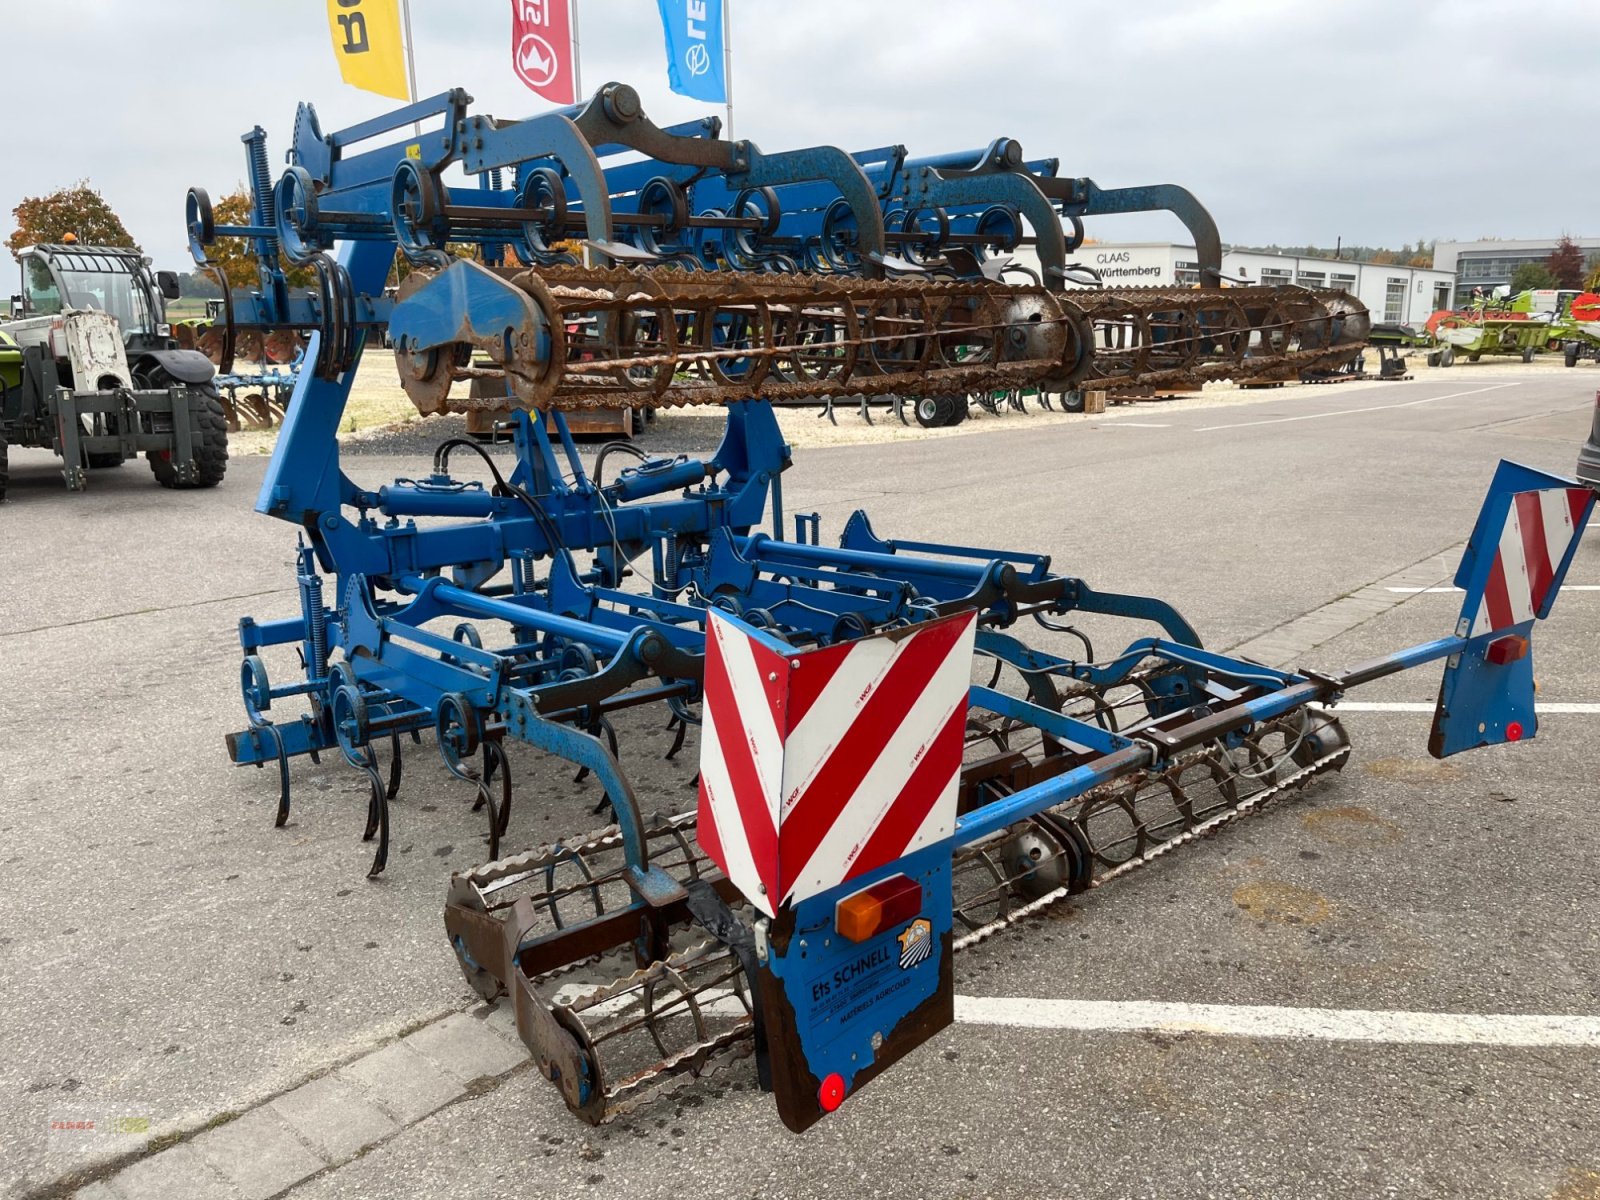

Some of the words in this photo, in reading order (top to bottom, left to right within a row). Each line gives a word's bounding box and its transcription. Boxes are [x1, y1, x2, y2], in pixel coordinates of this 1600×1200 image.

[1097, 252, 1130, 264] CLAAS
[1097, 266, 1161, 278] Württemberg
[812, 981, 831, 1002] Ets
[833, 946, 891, 989] SCHNELL
